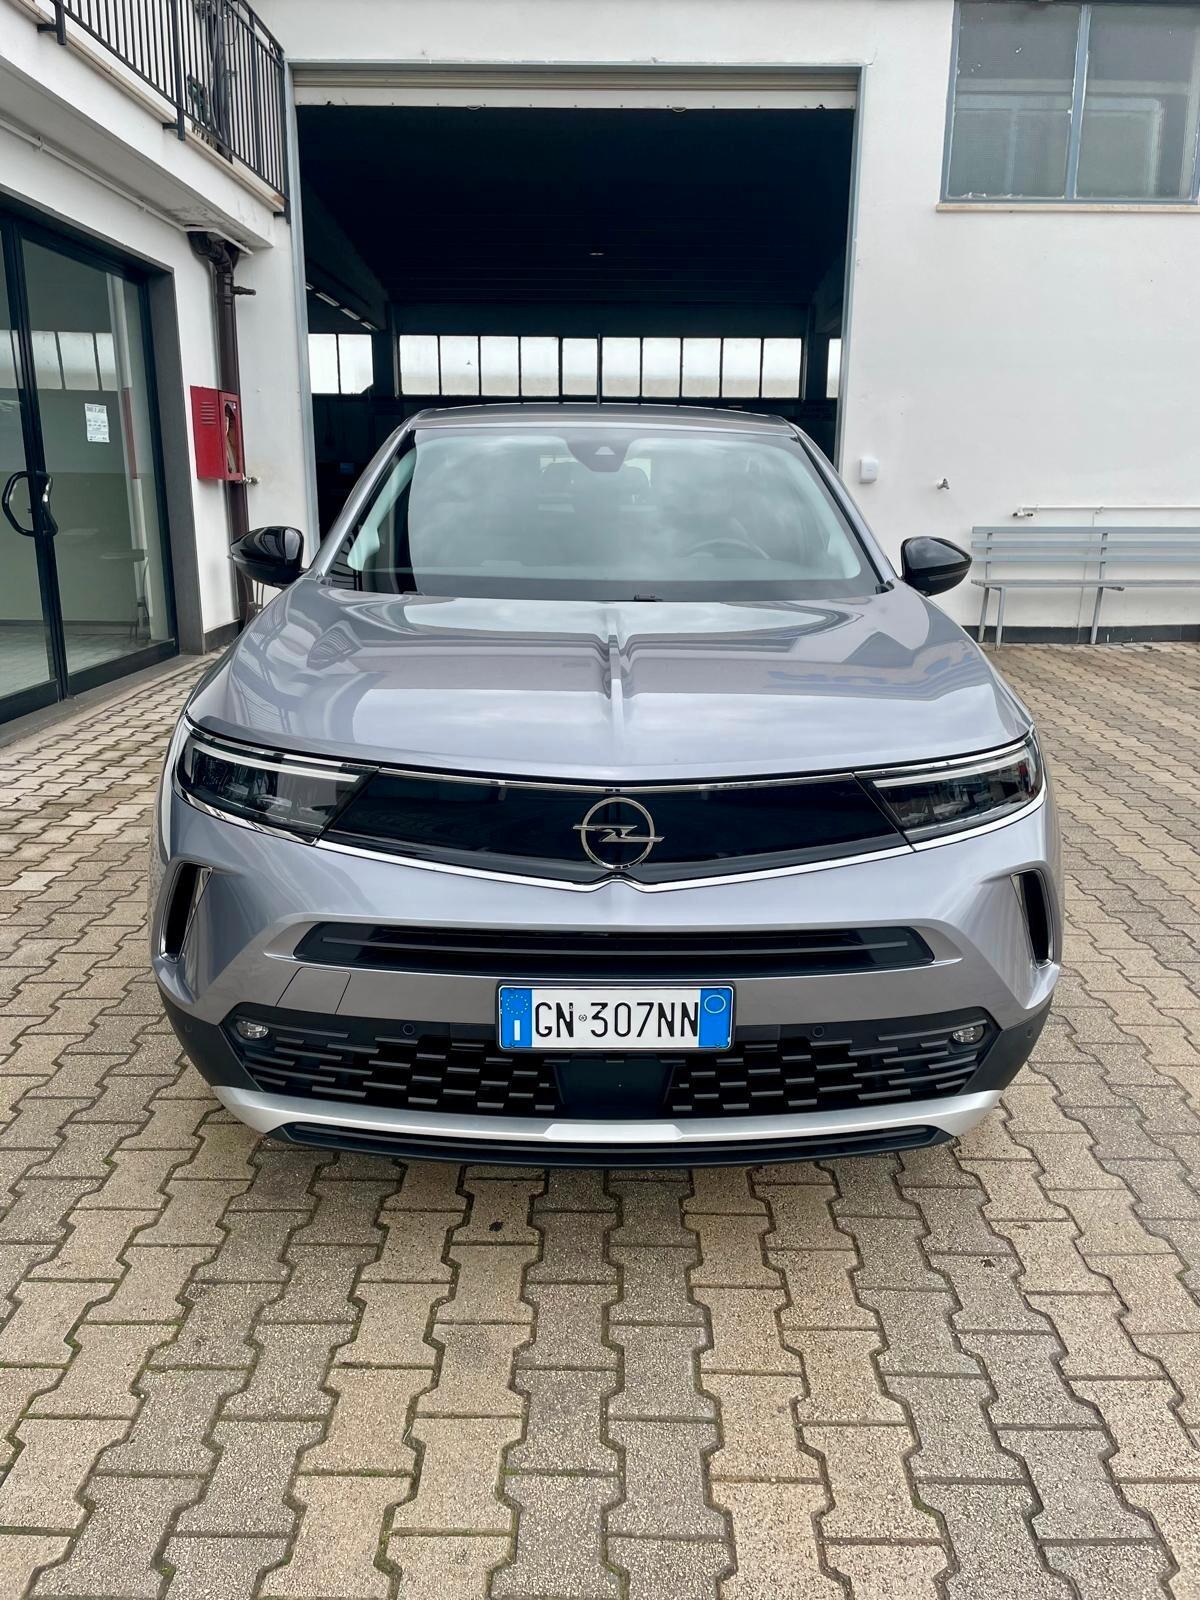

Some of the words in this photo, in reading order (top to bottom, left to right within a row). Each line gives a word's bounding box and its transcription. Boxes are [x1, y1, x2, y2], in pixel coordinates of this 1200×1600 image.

[513, 1019, 521, 1041] I
[535, 1001, 574, 1038] GN
[590, 1002, 699, 1038] 307NN
